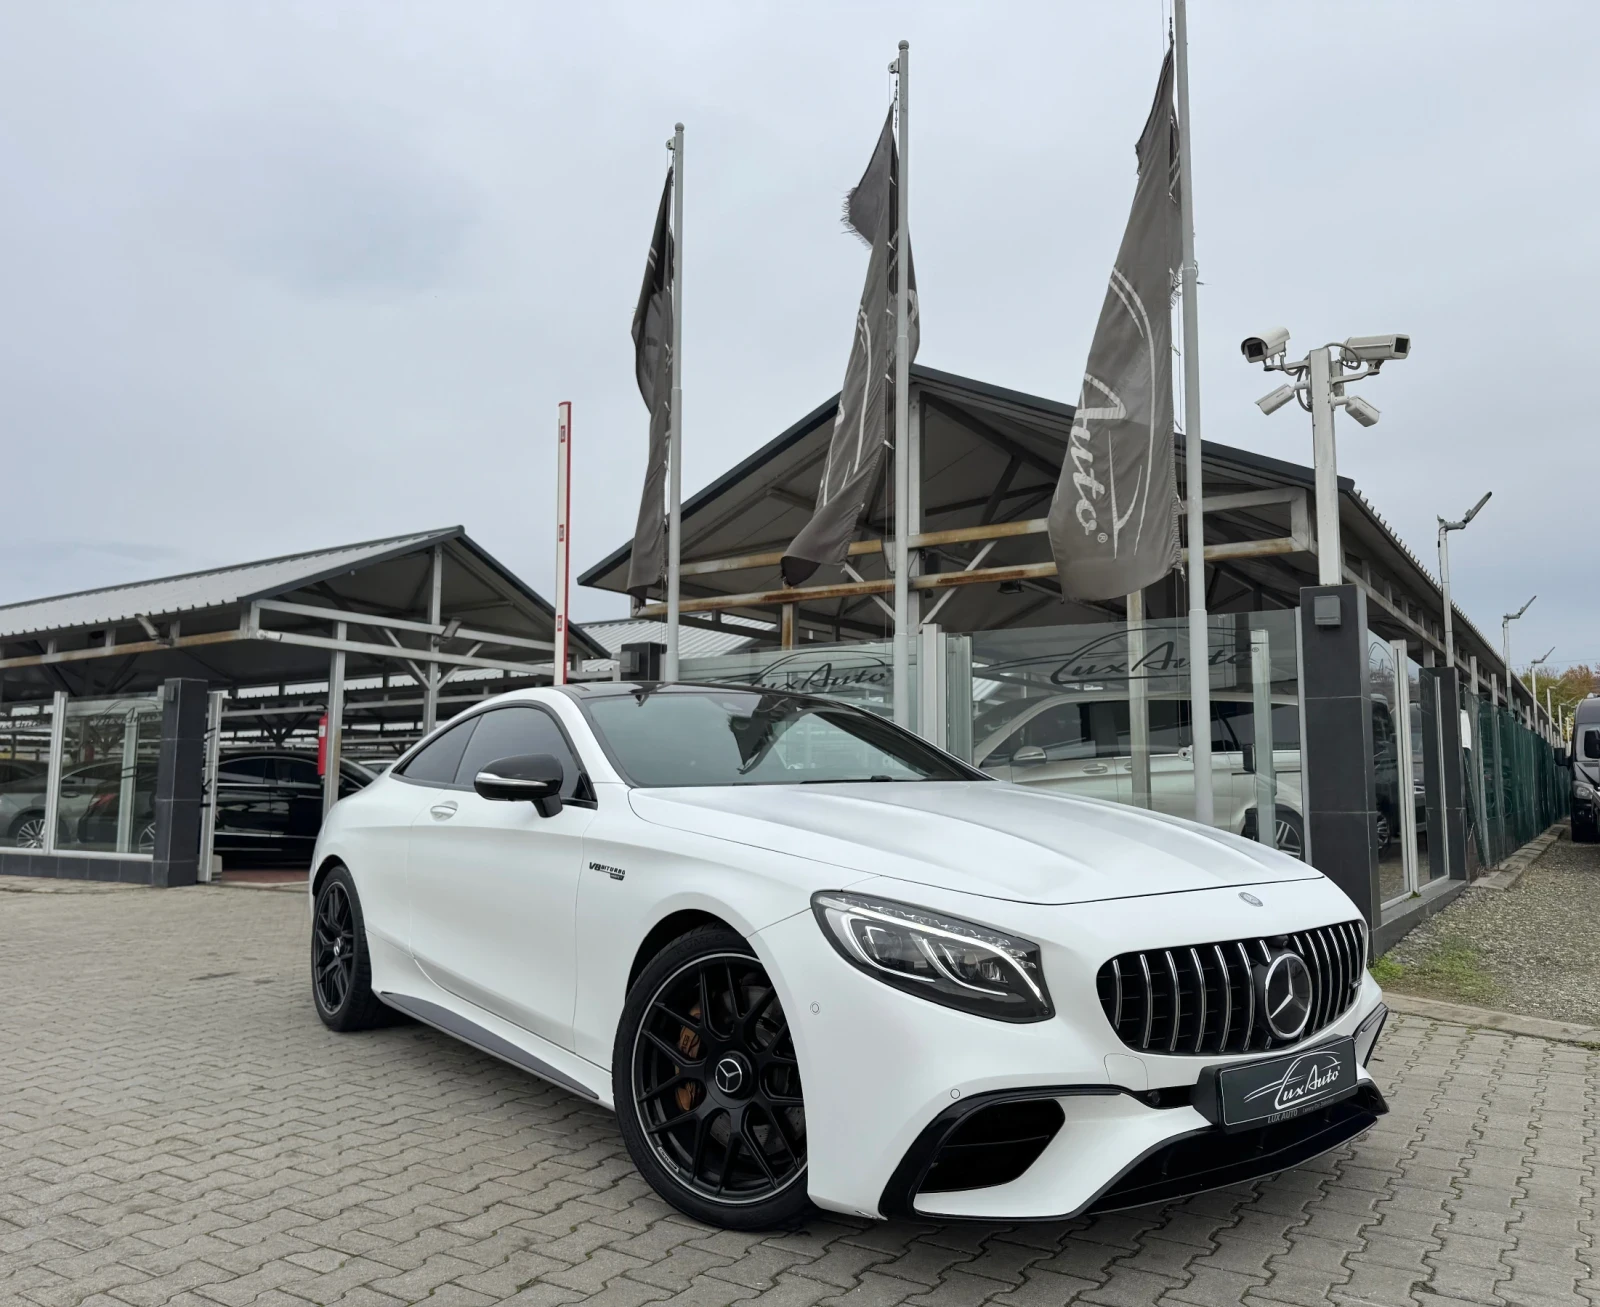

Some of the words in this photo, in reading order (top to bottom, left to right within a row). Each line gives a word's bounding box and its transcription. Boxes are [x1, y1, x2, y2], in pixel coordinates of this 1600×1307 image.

[589, 862, 601, 871] V8
[1267, 1112, 1280, 1124] LUX
[1281, 1109, 1298, 1120] AUTO
